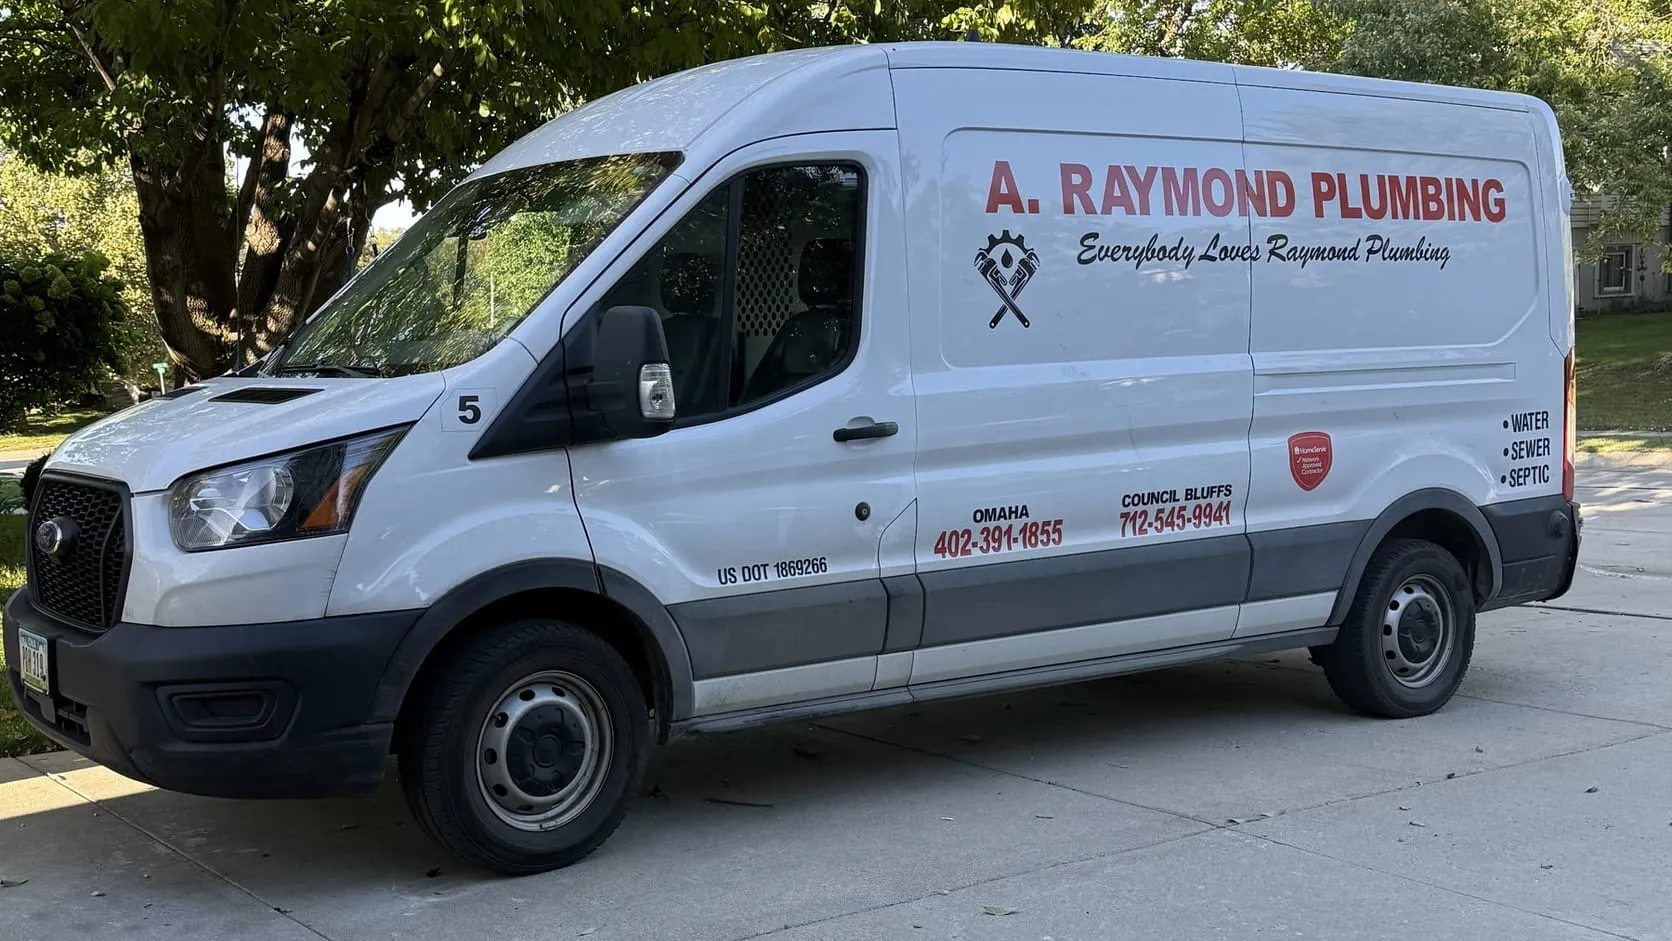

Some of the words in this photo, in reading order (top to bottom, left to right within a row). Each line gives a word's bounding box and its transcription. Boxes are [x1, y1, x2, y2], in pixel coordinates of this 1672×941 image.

[986, 161, 1040, 213] A.
[1060, 163, 1295, 217] RAYMOND
[1311, 172, 1506, 222] PLUMBING
[1077, 232, 1195, 270] Everybody
[1198, 233, 1261, 263] Loves
[1266, 233, 1361, 269] Raymond
[1365, 234, 1450, 269] Plumbing
[458, 395, 481, 424] 5
[1511, 411, 1549, 432] WATER
[1511, 438, 1550, 460] SEWER
[1509, 464, 1549, 487] SEPTIC
[1121, 490, 1180, 508] COUNCIL
[1184, 484, 1232, 501] BLUFFS
[972, 504, 1029, 523] OMAHA
[1120, 501, 1231, 537] 712-545-9941
[934, 519, 1063, 558] 402-391-1855
[718, 567, 737, 585] US
[742, 563, 769, 582] DOT
[774, 557, 828, 578] 1869266
